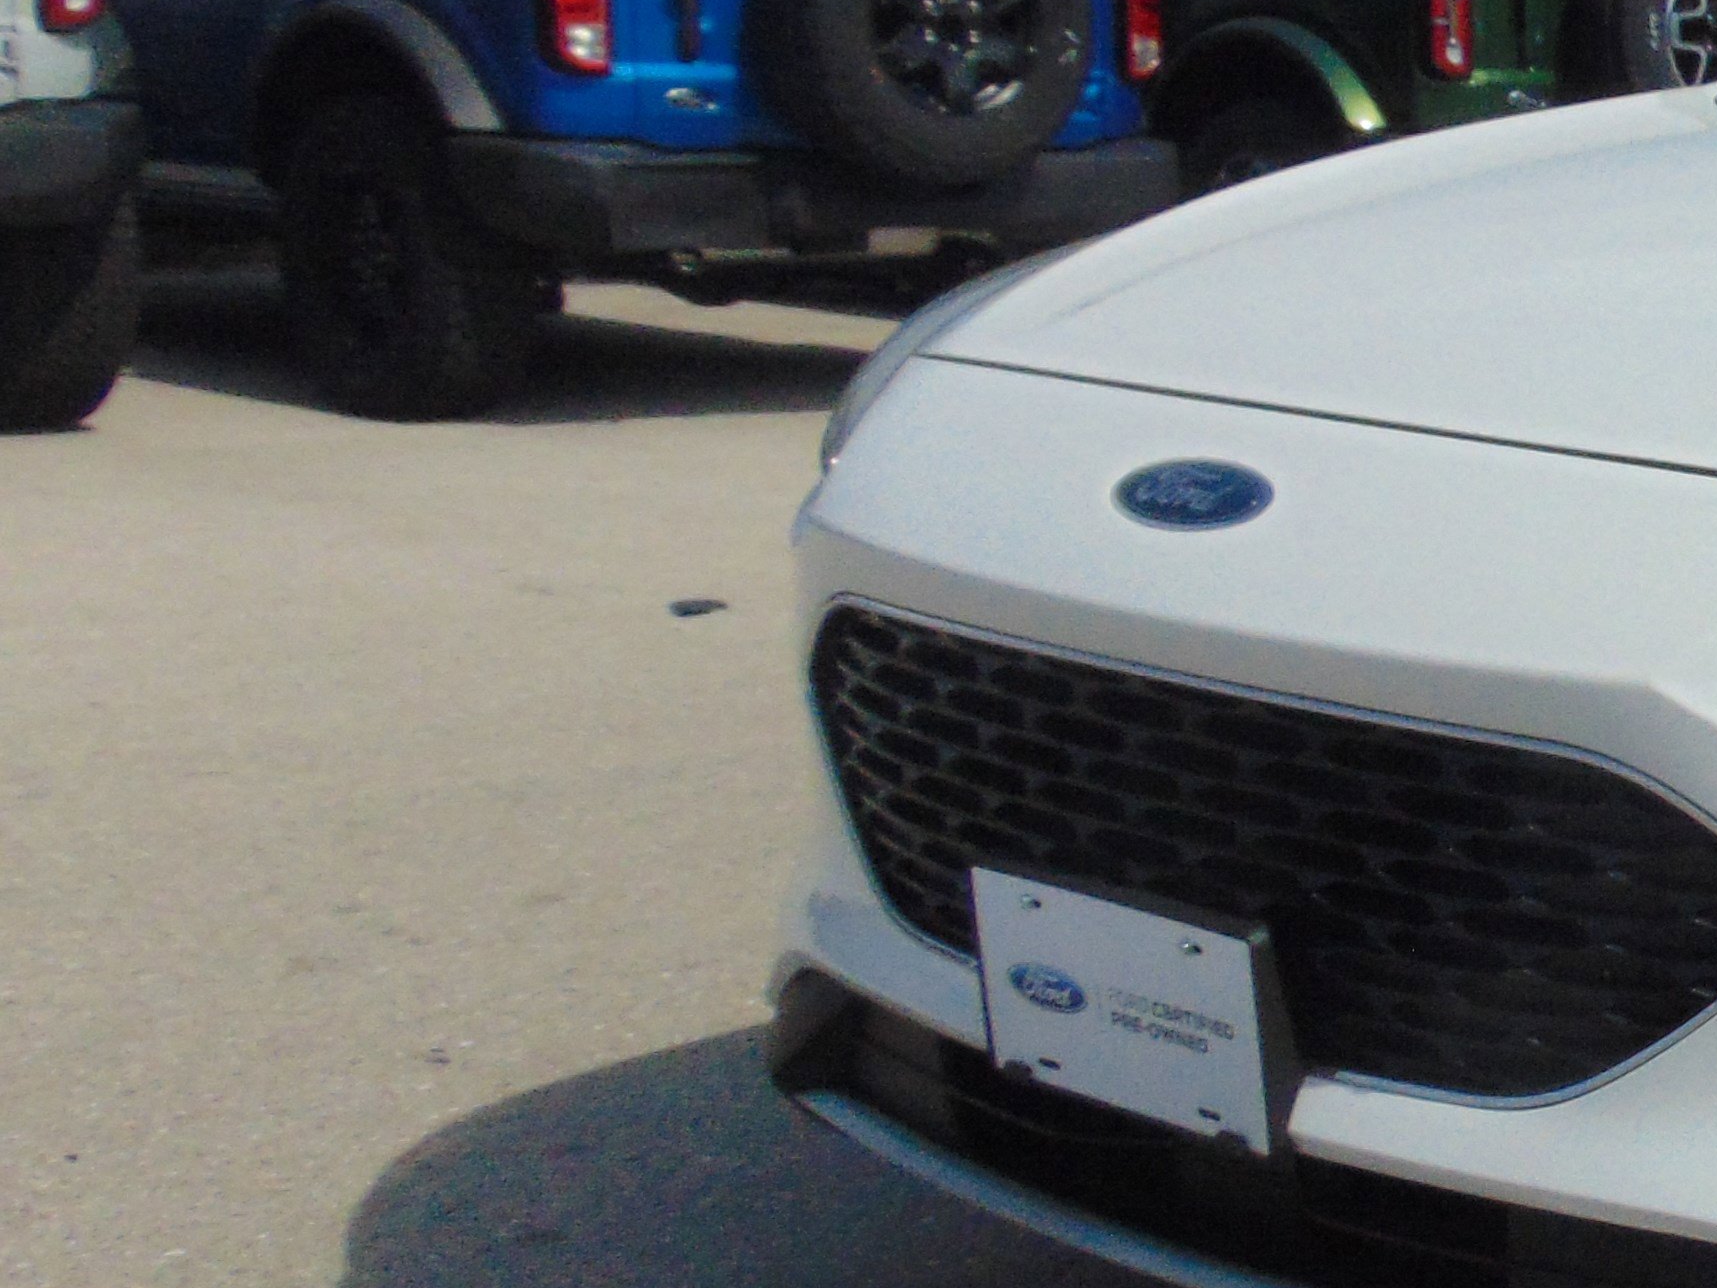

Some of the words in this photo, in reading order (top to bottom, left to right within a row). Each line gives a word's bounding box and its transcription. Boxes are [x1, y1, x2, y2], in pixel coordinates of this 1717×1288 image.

[1134, 464, 1236, 513] Ford
[1018, 968, 1076, 1010] Ford
[1110, 1011, 1209, 1054] PRE-OWNED
[1151, 1000, 1236, 1040] CERTIFIED
